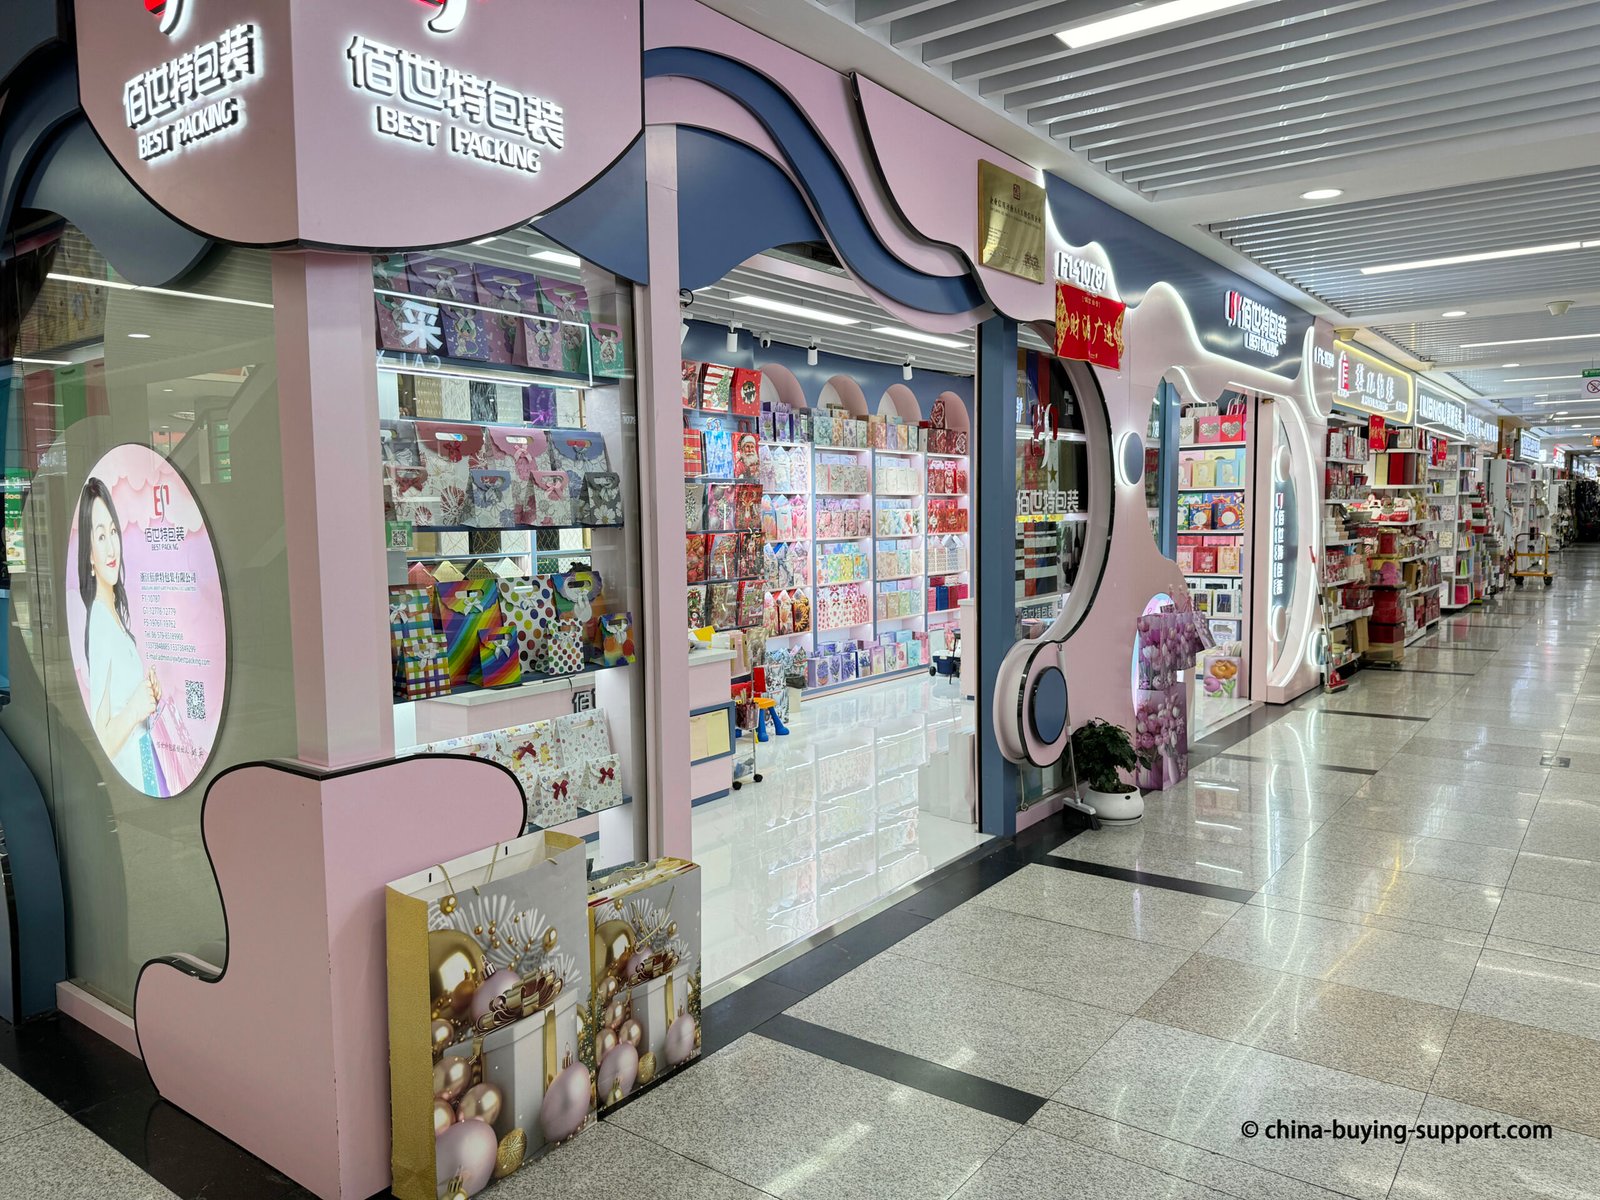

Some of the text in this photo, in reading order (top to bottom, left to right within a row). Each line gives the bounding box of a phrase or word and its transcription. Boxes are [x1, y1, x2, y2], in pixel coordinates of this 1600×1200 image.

[123, 24, 254, 128] 佰世特包装
[347, 35, 563, 149] 佰世特包装
[138, 98, 236, 160] BEST PACKING
[377, 105, 541, 173] BEST PACKING
[1240, 296, 1287, 345] 佰世特包装
[1016, 489, 1079, 515] 佰世特包装
[144, 526, 185, 543] 佰世特包装
[152, 543, 161, 551] BEST
